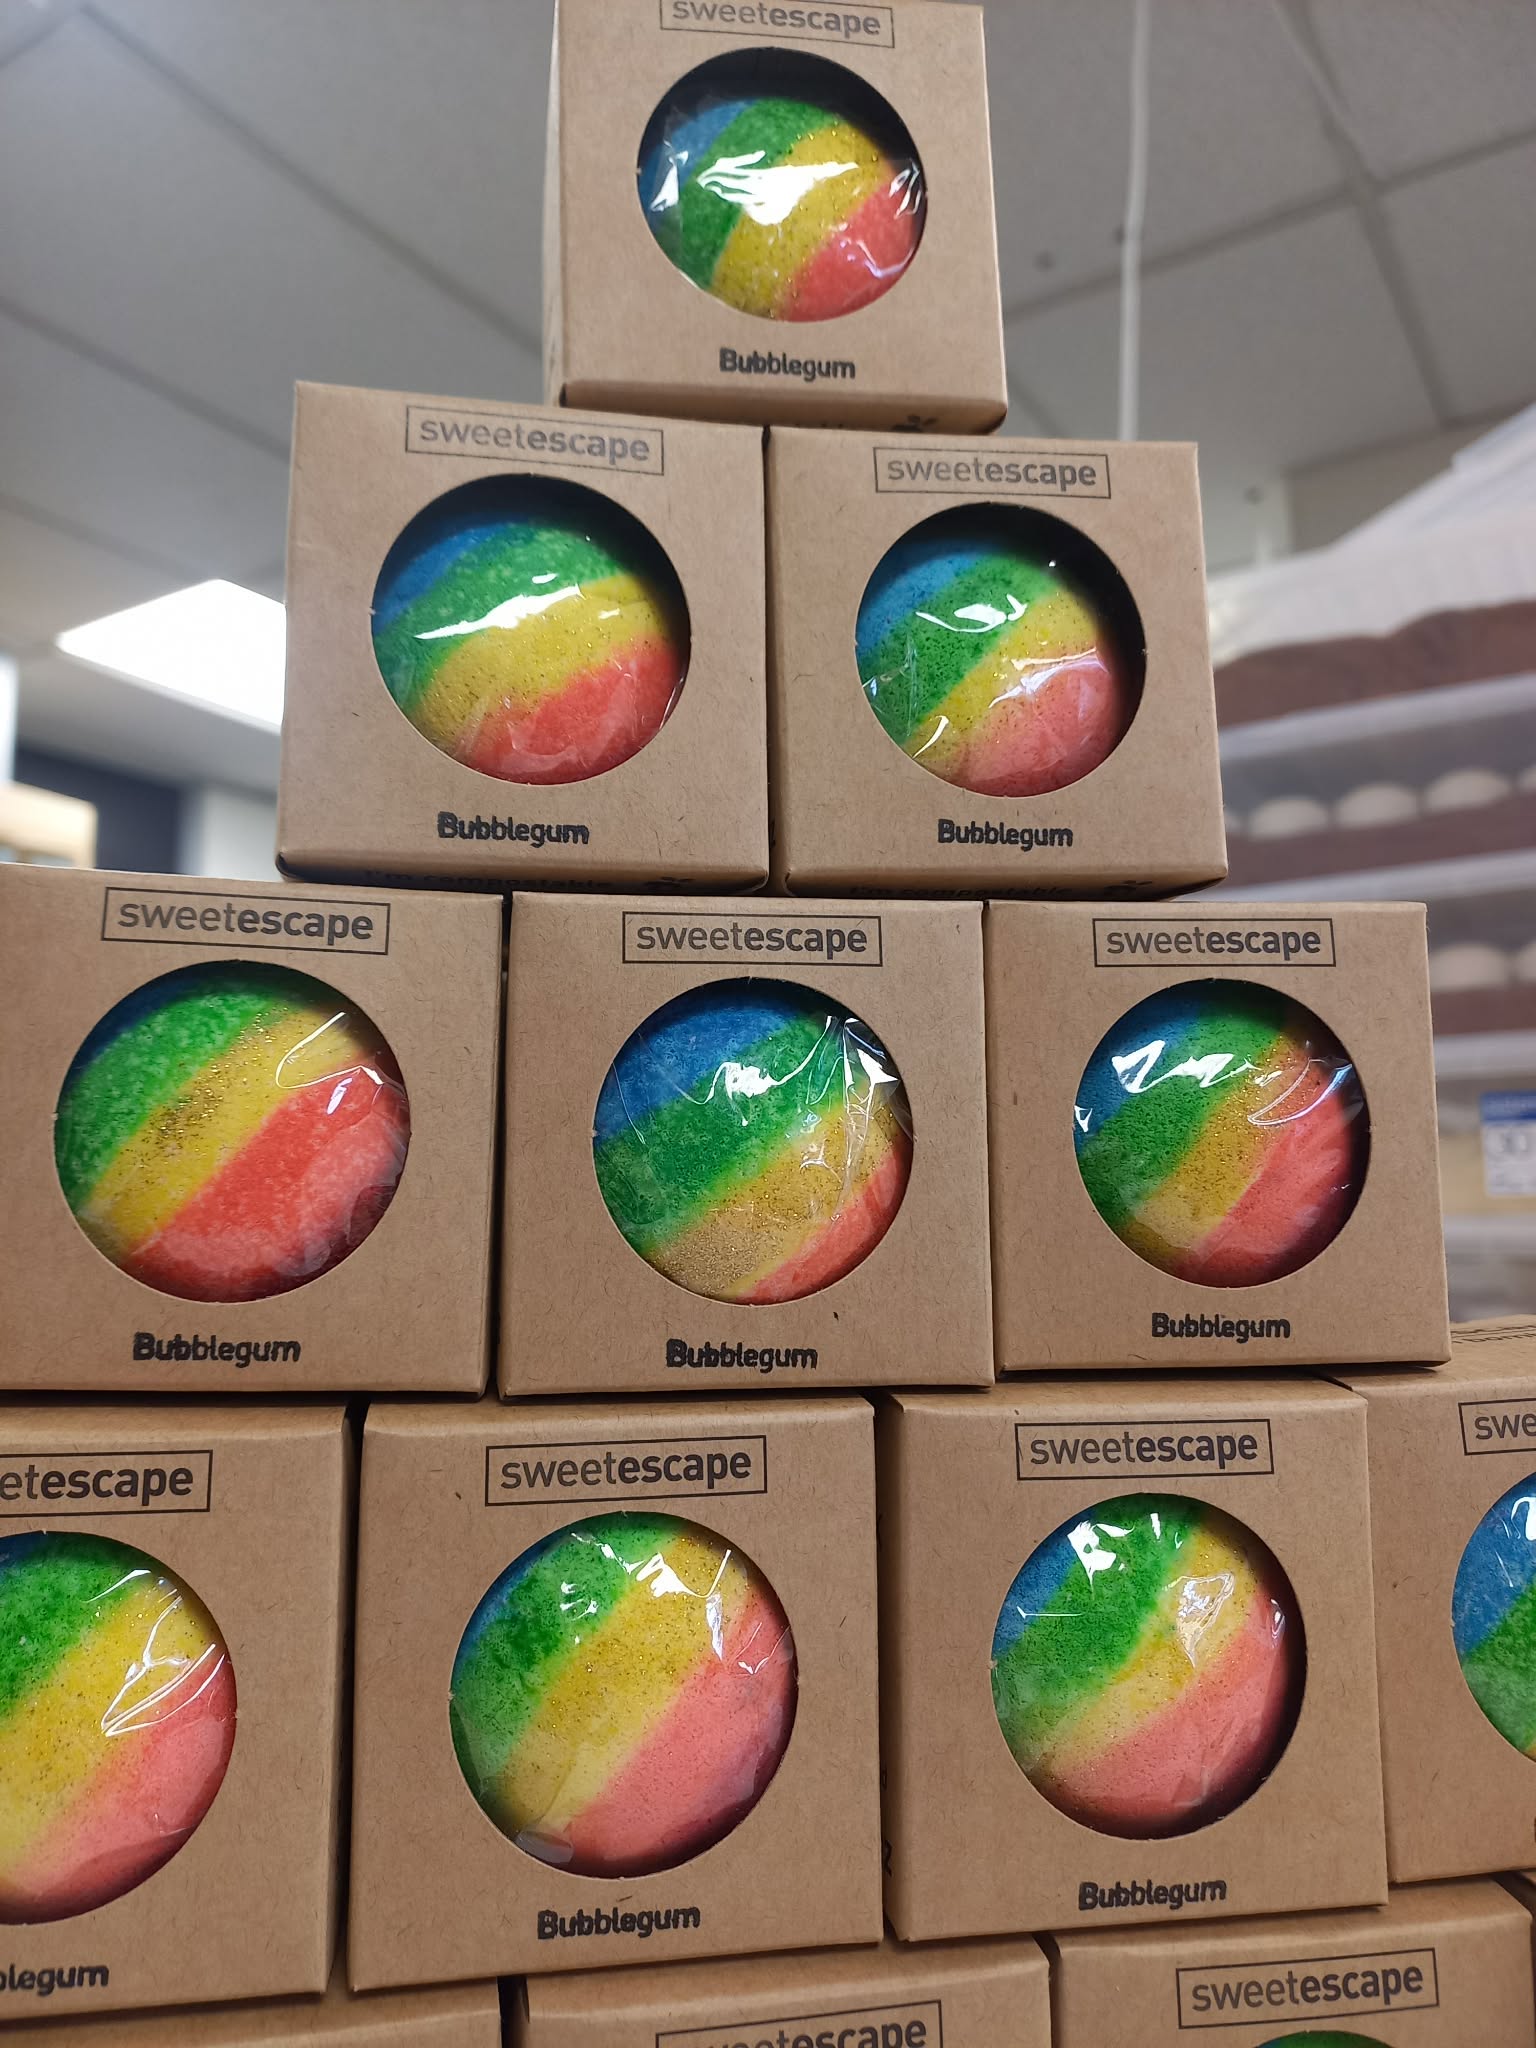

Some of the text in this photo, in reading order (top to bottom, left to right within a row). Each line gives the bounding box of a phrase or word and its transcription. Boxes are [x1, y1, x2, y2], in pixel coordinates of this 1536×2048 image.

[672, 1, 882, 39] sweetescape
[719, 347, 856, 383] Bubblegum
[419, 416, 650, 465] sweetescape
[887, 457, 1097, 489] sweetescape
[437, 811, 590, 849] Bubblegum
[937, 818, 1074, 853] Bubblegum
[118, 902, 375, 946] sweetescape
[636, 922, 868, 960] sweetescape
[1106, 926, 1321, 961] sweetescape
[1151, 1312, 1291, 1345] Bubblegum
[132, 1331, 302, 1369] Bubblegum
[665, 1337, 819, 1374] Bubblegum
[1030, 1431, 1258, 1470] sweetescape
[500, 1450, 752, 1490] sweetescape
[1078, 1878, 1228, 1911] Bubblegum
[536, 1906, 701, 1940] Bubblegum
[1190, 1963, 1424, 2012] sweetescape
